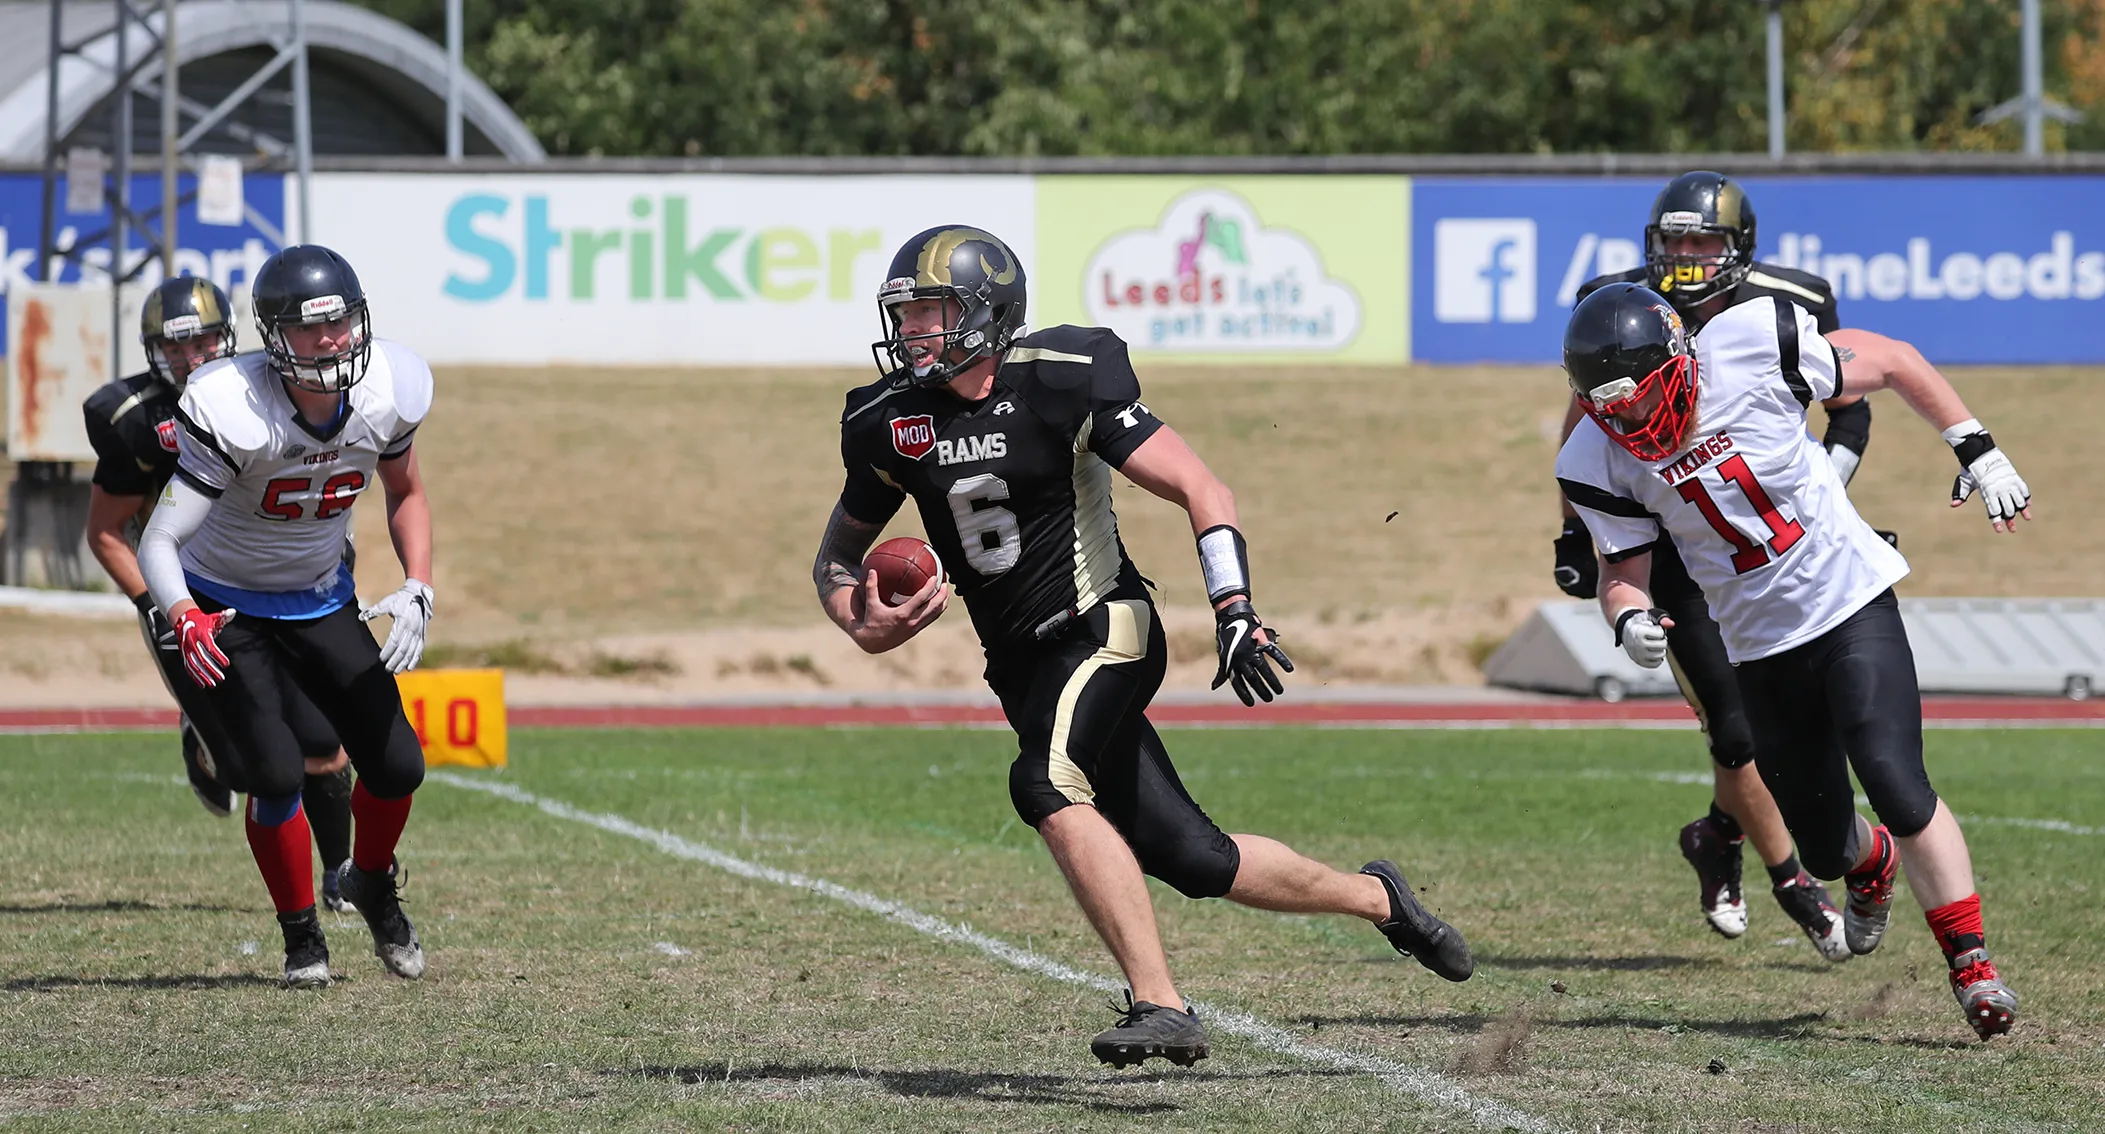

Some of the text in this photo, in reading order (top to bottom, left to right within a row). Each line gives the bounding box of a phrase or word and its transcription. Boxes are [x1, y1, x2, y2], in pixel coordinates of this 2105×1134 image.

[441, 190, 882, 303] Striker
[310, 299, 334, 309] Riddell
[1104, 266, 1226, 308] Leeds
[1150, 312, 1203, 342] get
[897, 424, 930, 446] MOD
[936, 432, 1007, 467] RAMS
[303, 449, 339, 466] VIKINGS
[1658, 429, 1734, 487] VIKINGS
[946, 472, 1022, 576] 6
[1674, 452, 1806, 575] 11
[411, 696, 478, 749] 10
